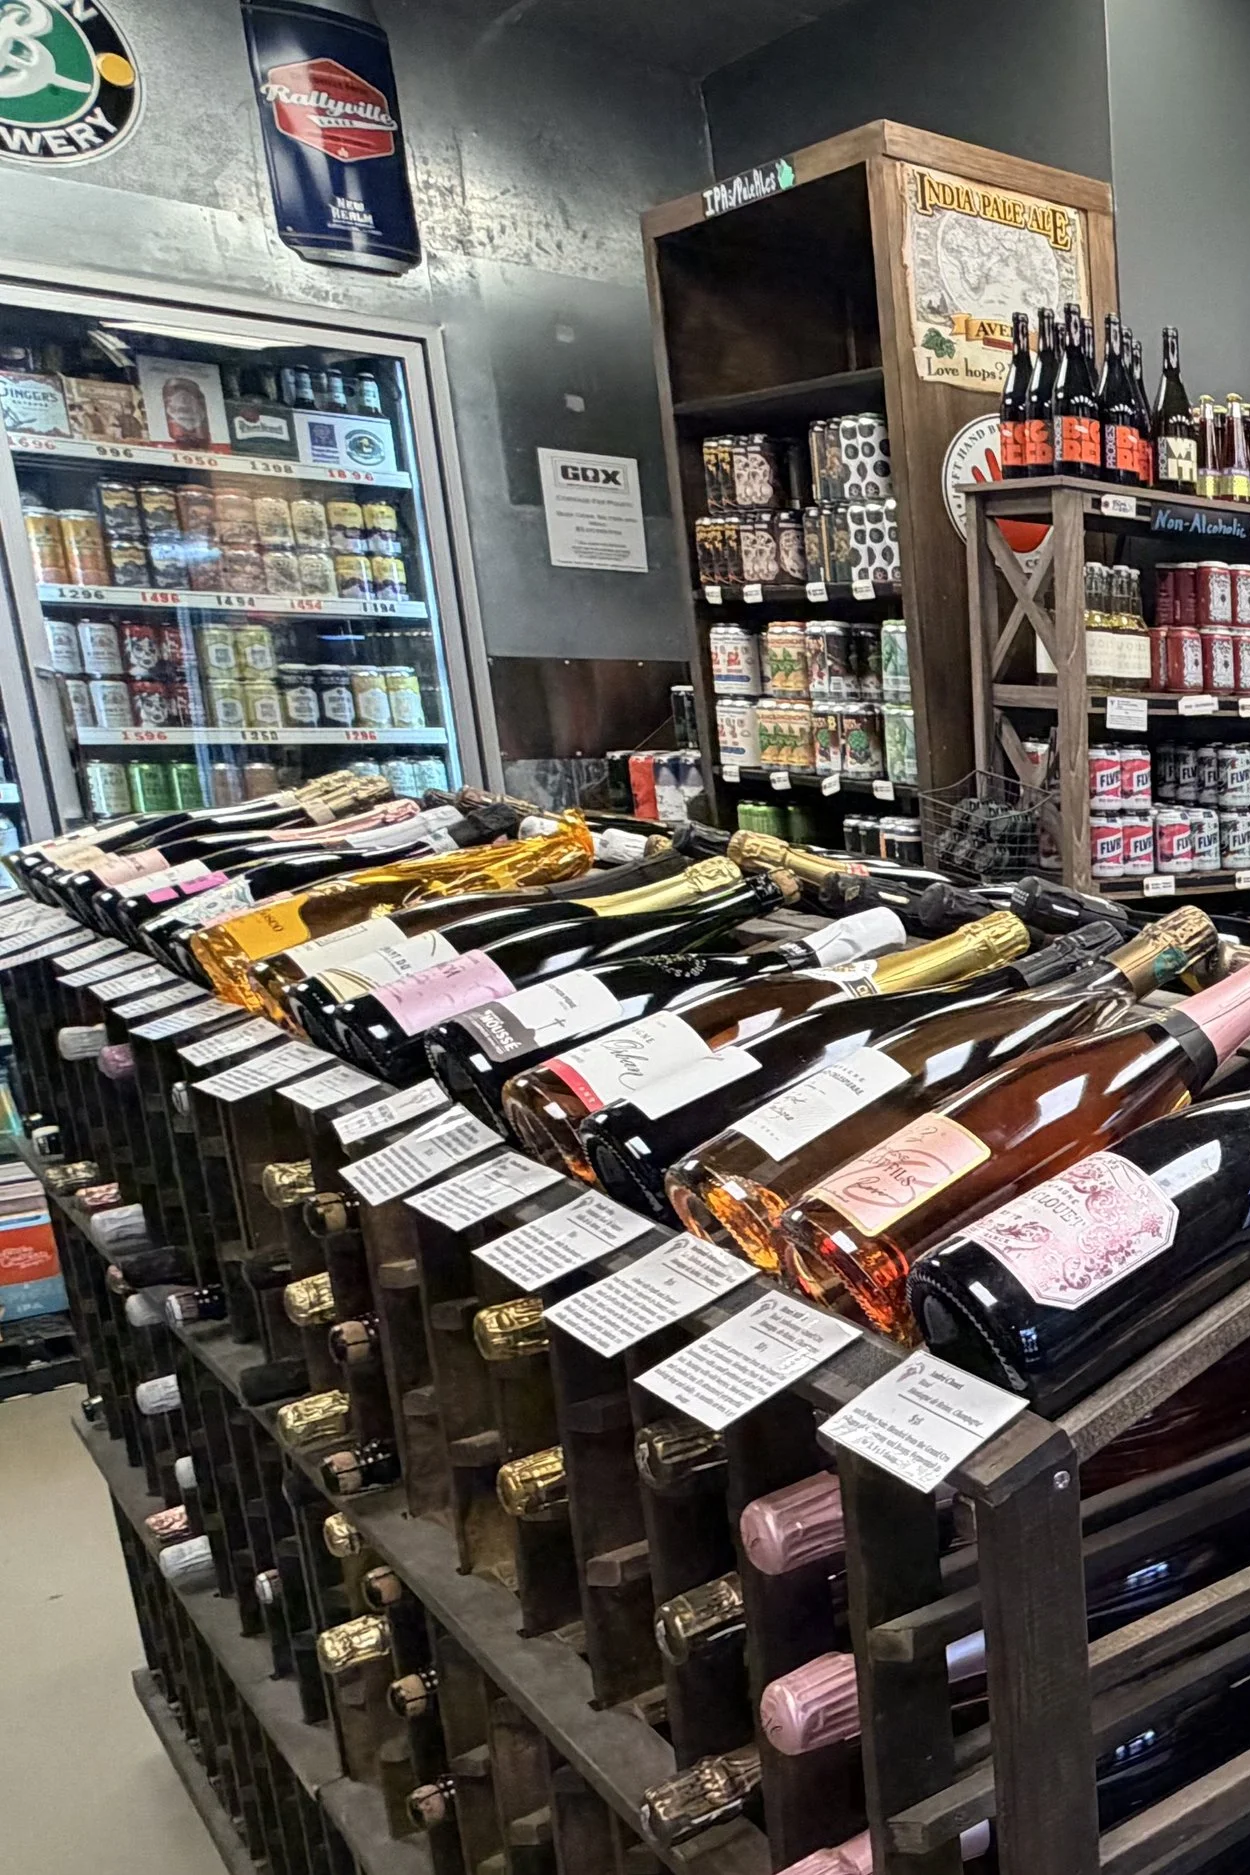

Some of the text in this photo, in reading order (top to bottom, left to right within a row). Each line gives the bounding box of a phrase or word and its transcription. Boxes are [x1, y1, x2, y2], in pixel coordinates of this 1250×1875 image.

[260, 84, 396, 123] Rallyville
[0, 107, 118, 155] WERY
[914, 171, 1071, 248] INDIA PALE ALE
[975, 322, 1013, 338] AVE
[927, 357, 1005, 380] Love hops?
[957, 428, 986, 460] HAND
[1155, 510, 1247, 539] Non-Alcoholic
[58, 588, 105, 600] 1296
